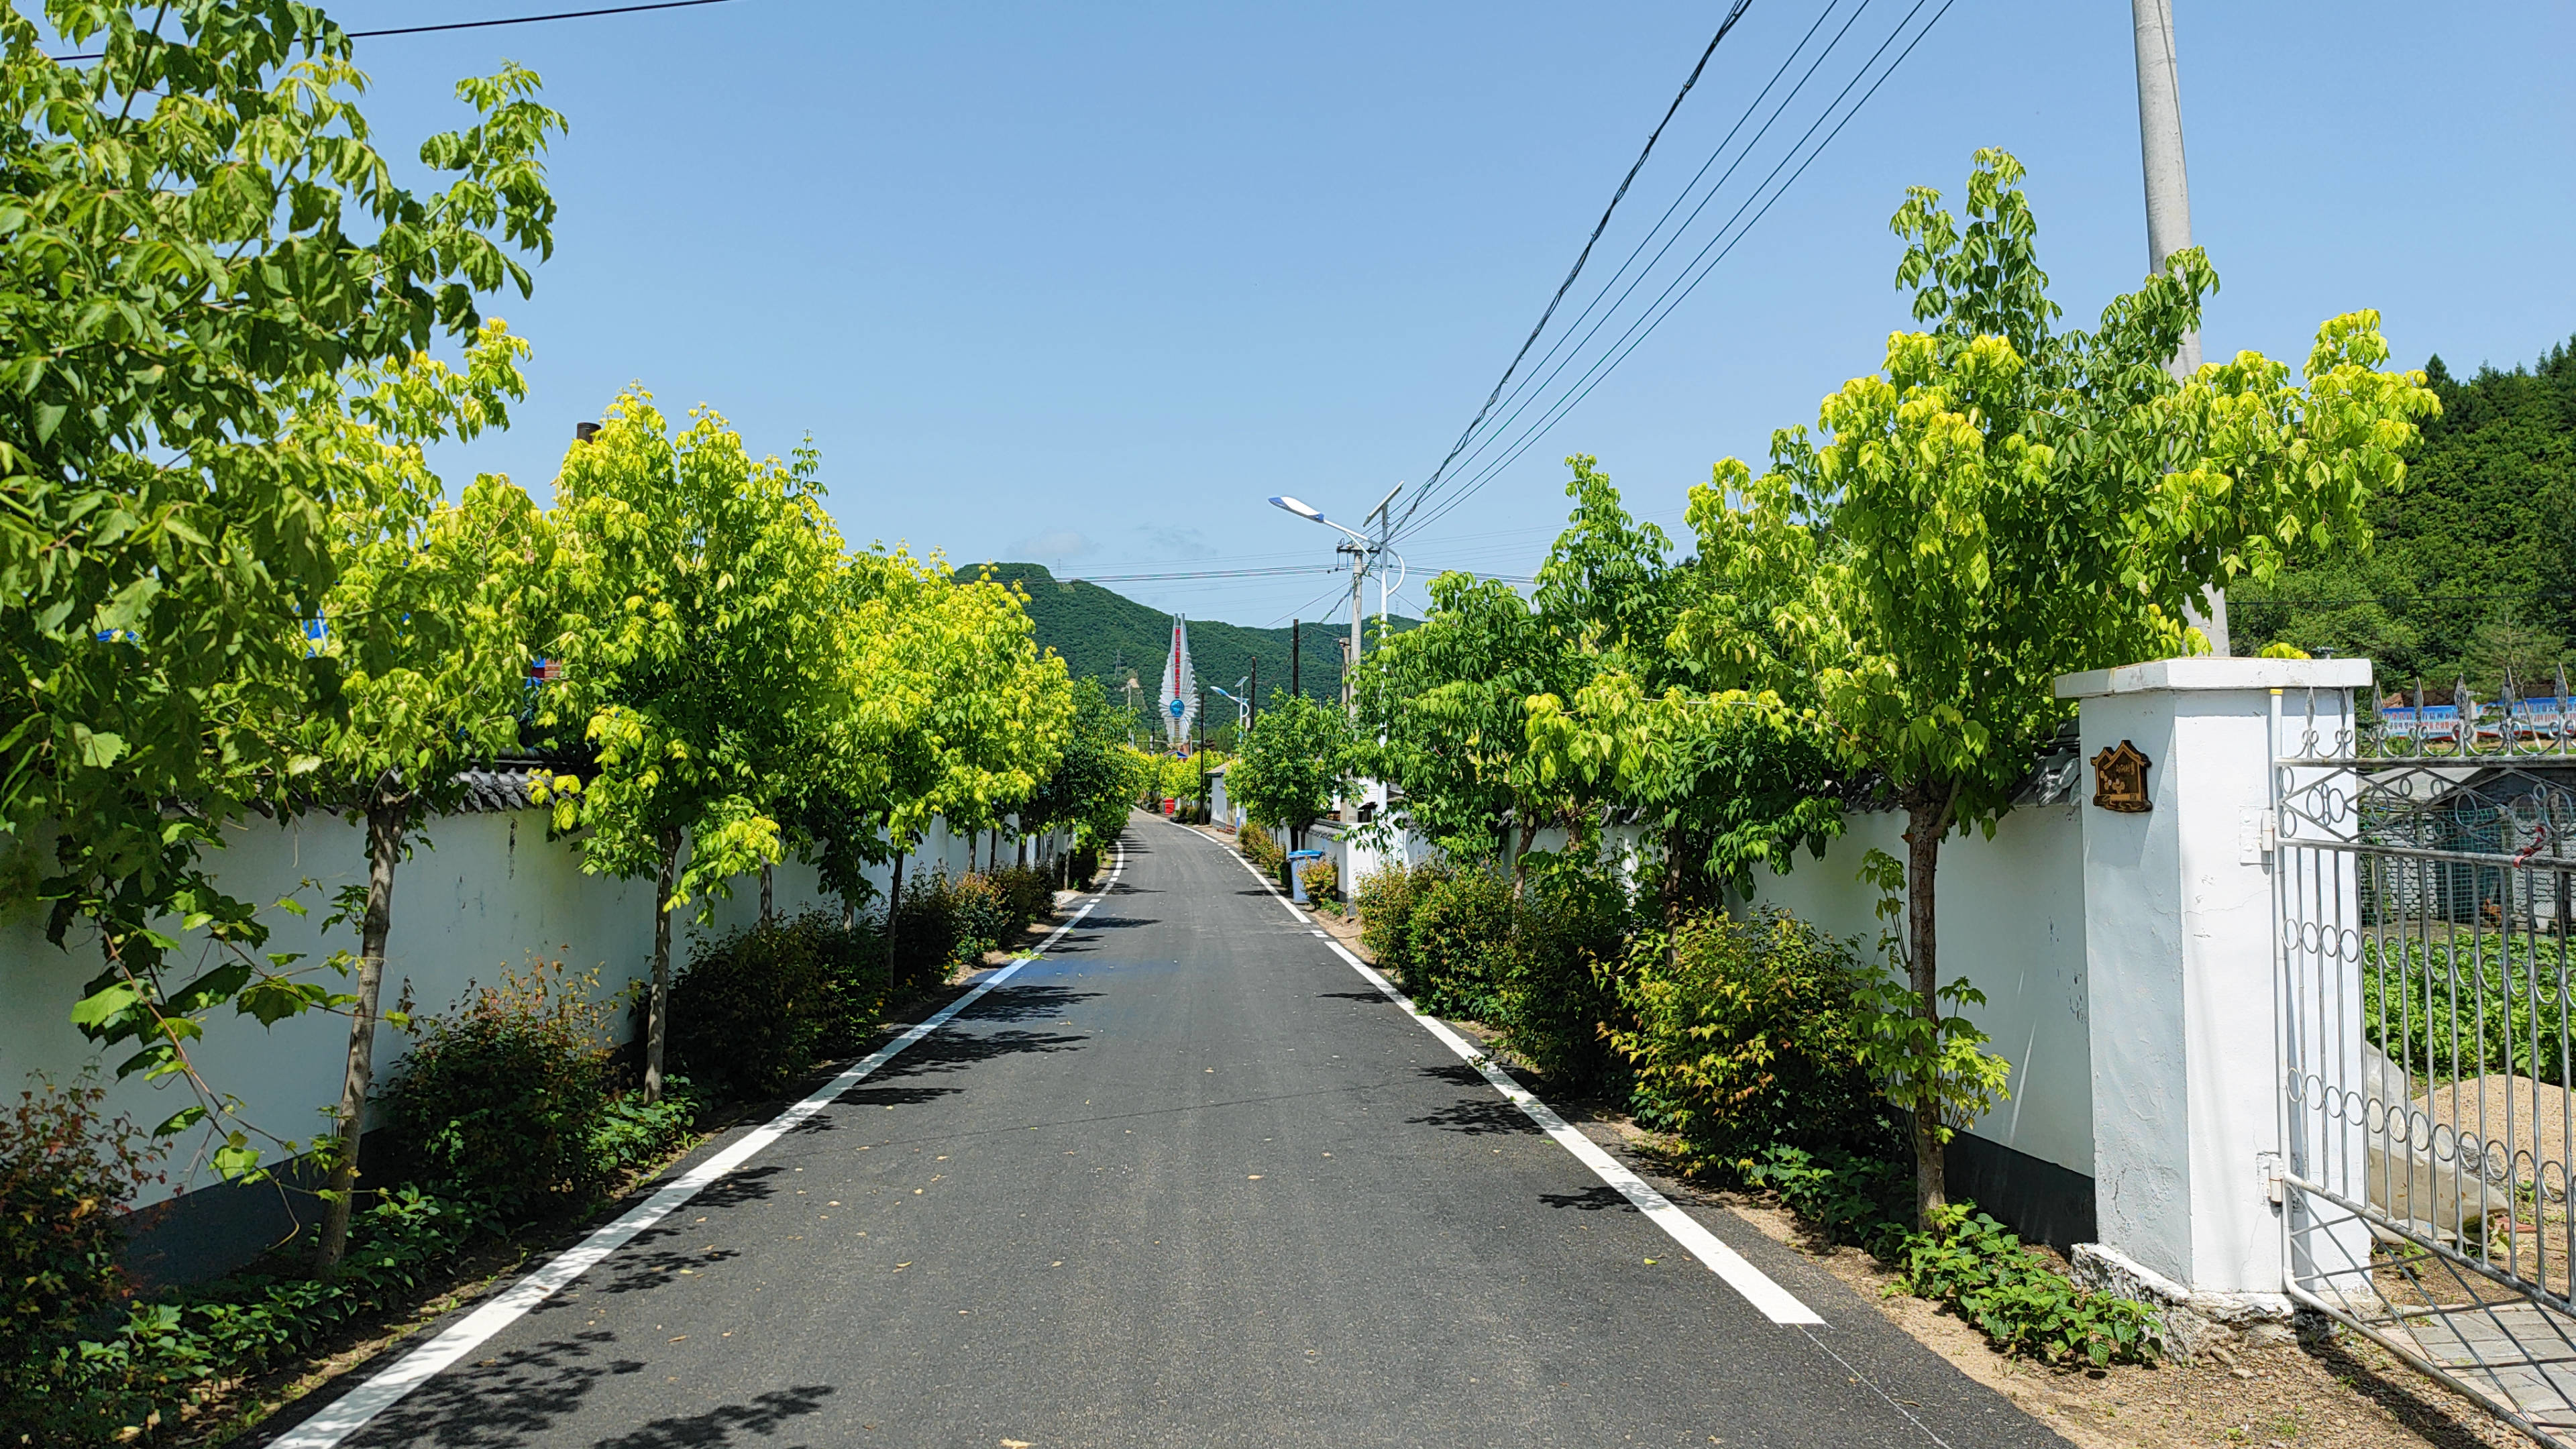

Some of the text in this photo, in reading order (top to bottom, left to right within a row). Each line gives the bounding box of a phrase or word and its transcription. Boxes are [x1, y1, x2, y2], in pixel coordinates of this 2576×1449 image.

[2384, 712, 2459, 720] 中华民族有精神家园
